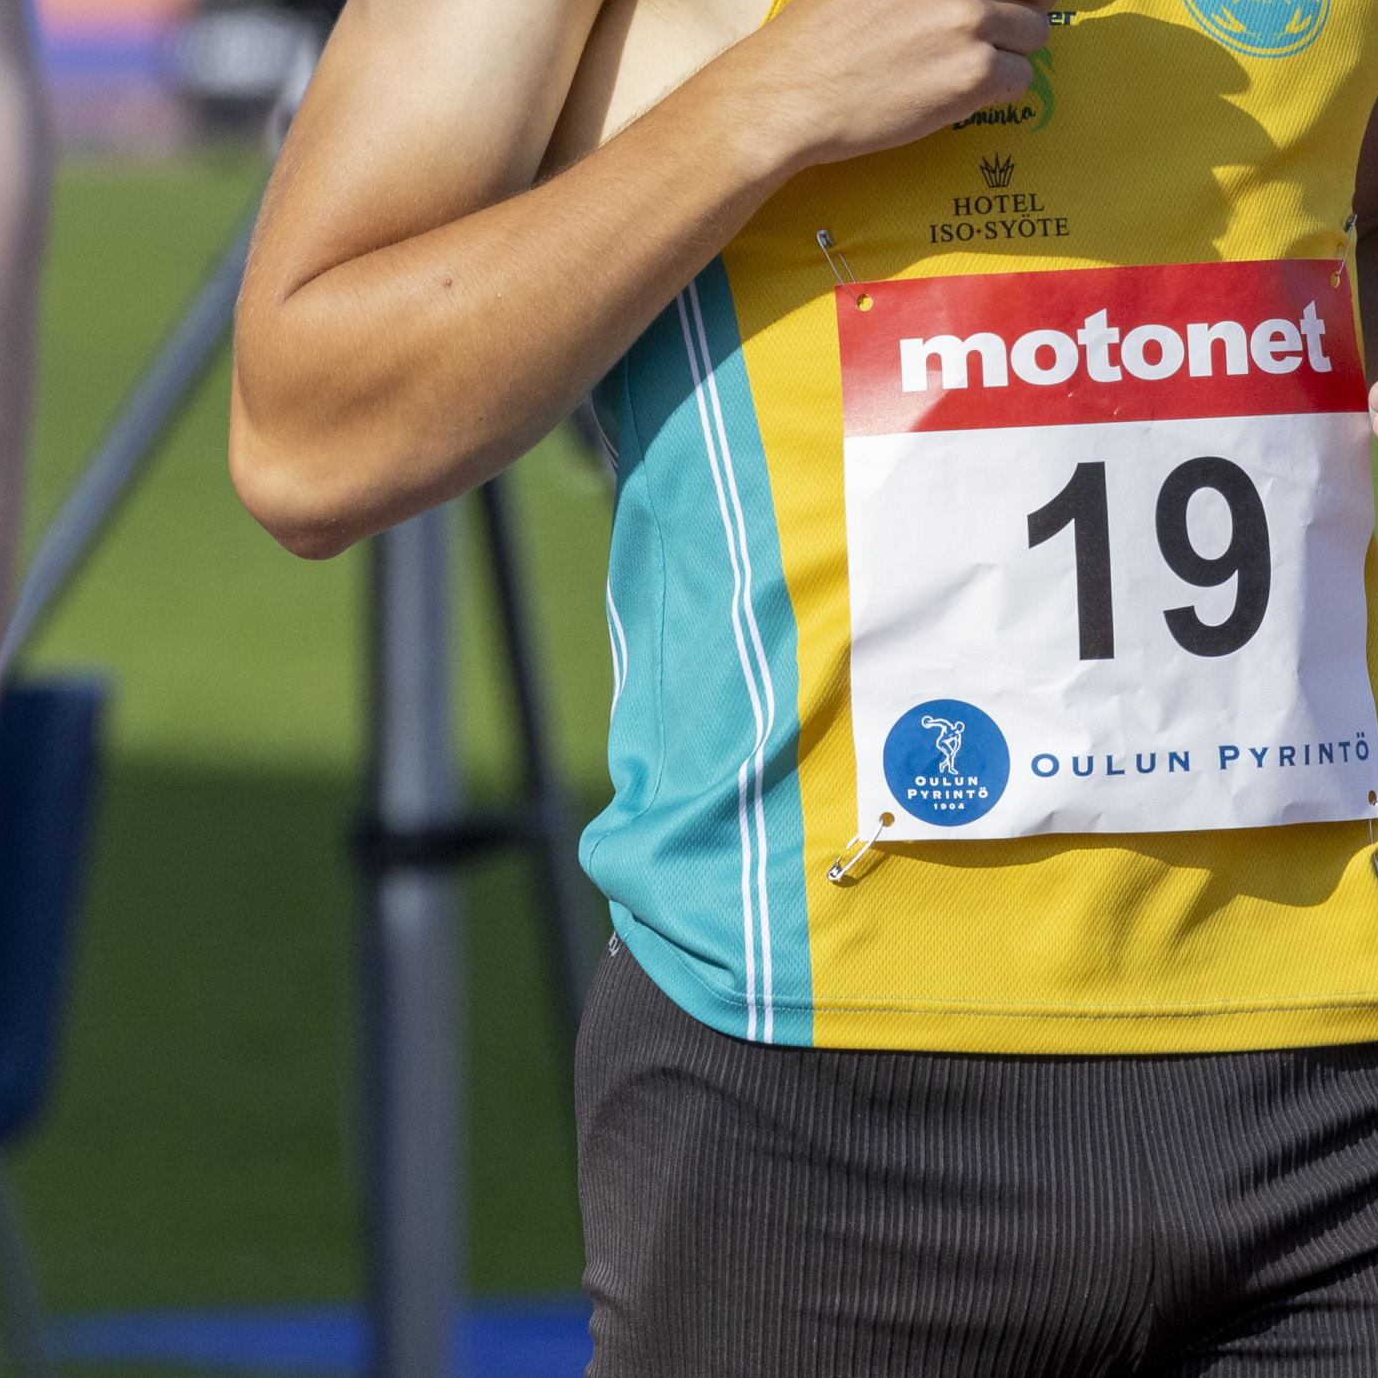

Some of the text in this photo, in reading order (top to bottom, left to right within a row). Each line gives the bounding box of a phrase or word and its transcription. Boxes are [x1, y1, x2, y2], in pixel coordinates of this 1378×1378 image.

[953, 193, 1045, 216] HOTEL
[899, 299, 1333, 393] motonet
[1026, 455, 1272, 661] 19
[1030, 731, 1370, 778] OULUN PYRINTÖ
[914, 775, 979, 787] OULUN
[907, 786, 989, 800] PYRINTÖ
[932, 802, 965, 810] 1904
